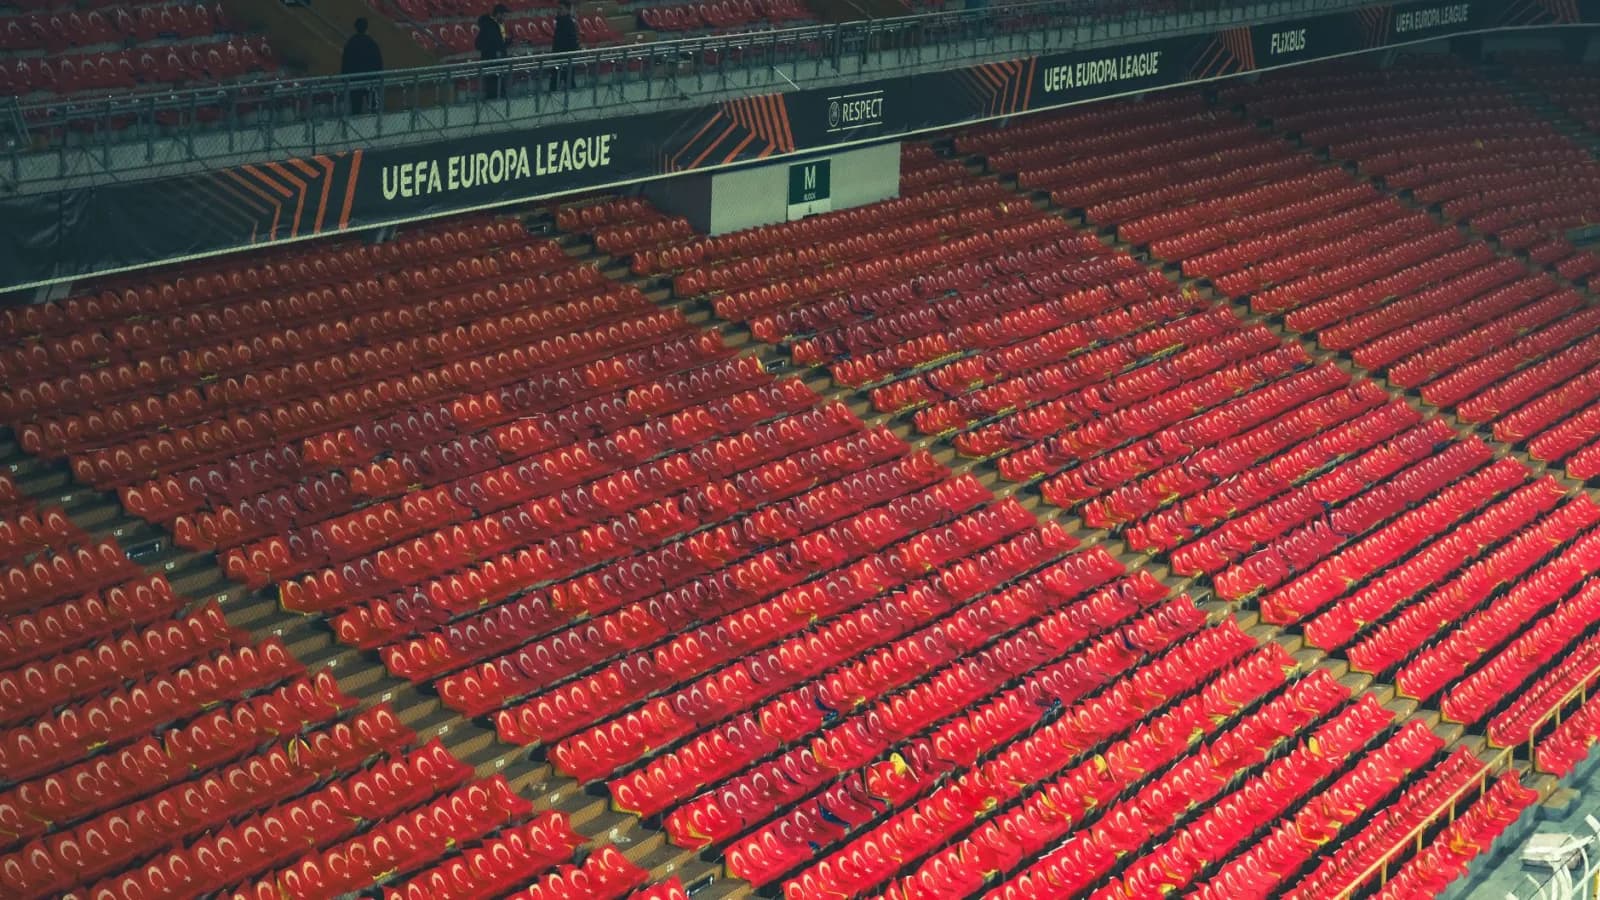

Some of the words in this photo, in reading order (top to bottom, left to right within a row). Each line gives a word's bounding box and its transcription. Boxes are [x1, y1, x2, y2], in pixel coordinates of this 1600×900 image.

[1396, 12, 1414, 32] UEFA
[1415, 8, 1440, 30] EUROPA
[1441, 4, 1468, 24] LEAGUE
[1044, 65, 1074, 92] UEFA
[1076, 58, 1118, 87] EUROPA
[1120, 51, 1159, 80] LEAGUE
[842, 98, 883, 122] RESPECT
[382, 160, 442, 200] UEFA
[448, 146, 531, 190] EUROPA
[536, 134, 611, 176] LEAGUE
[804, 165, 816, 190] M
